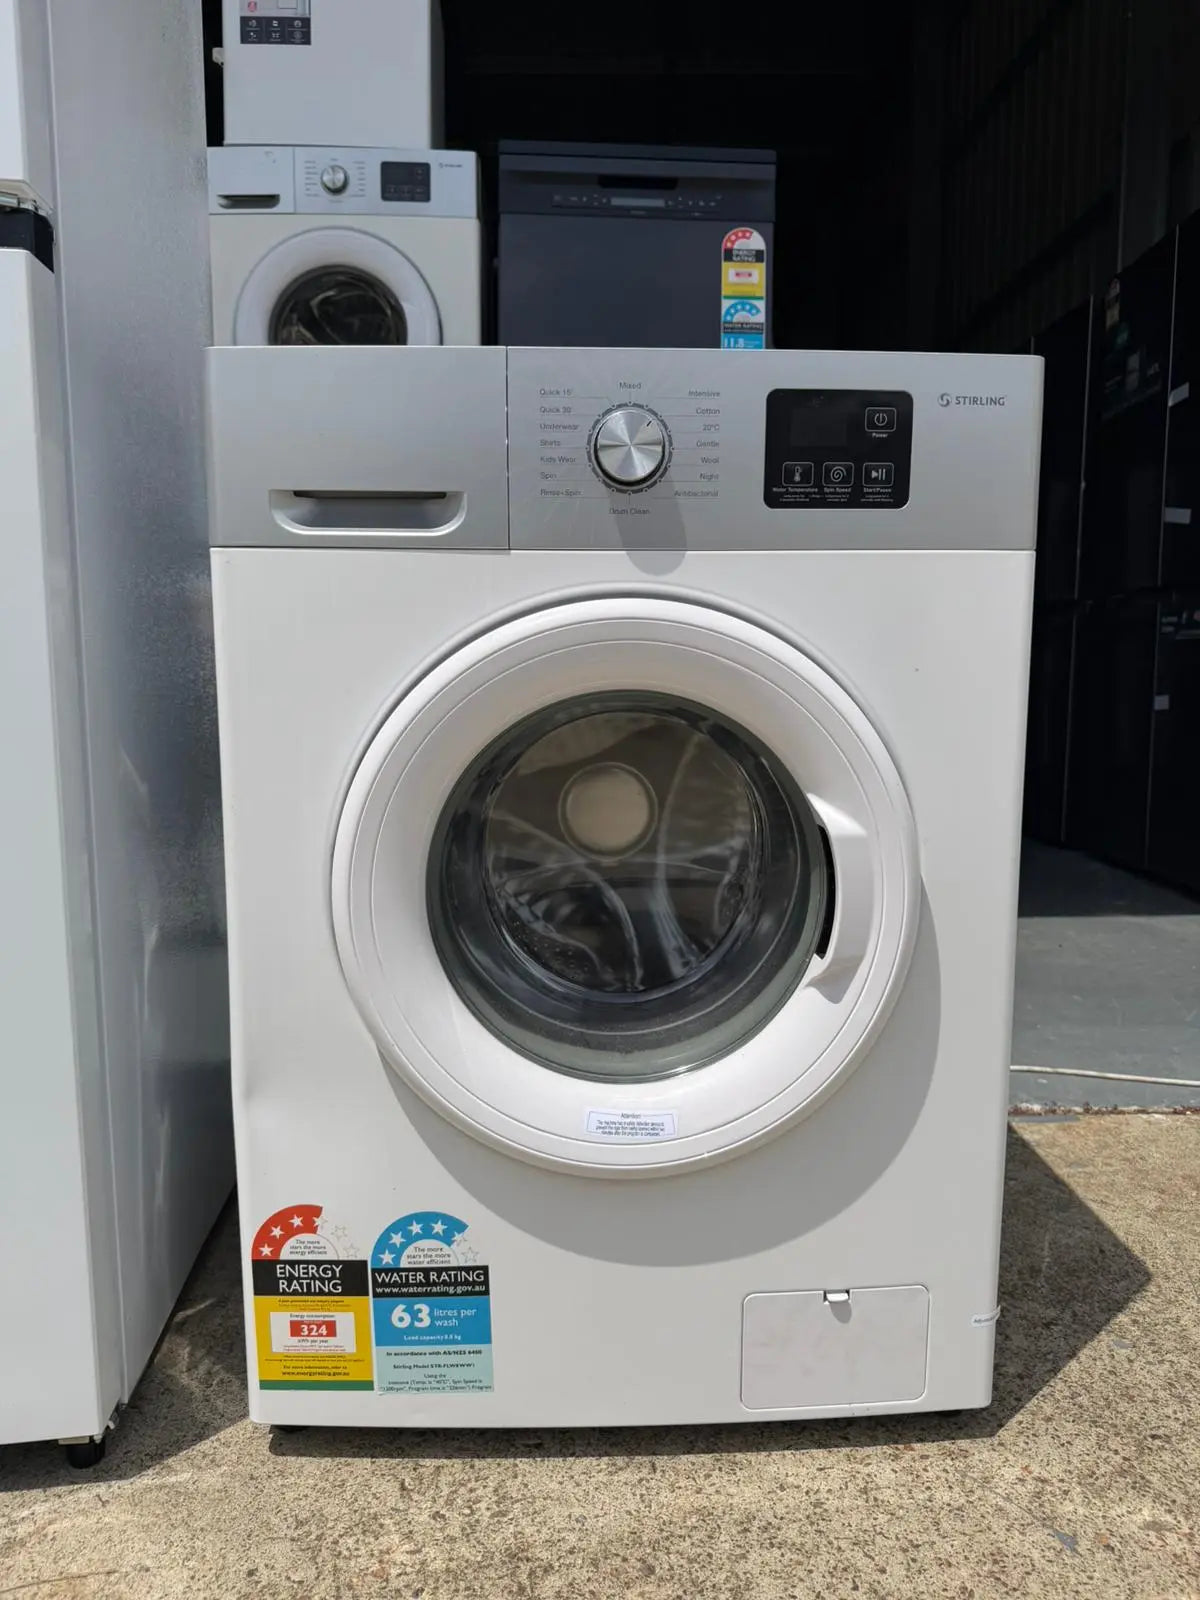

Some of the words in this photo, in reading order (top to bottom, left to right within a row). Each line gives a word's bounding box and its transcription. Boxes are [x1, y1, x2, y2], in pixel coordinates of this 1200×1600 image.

[955, 396, 1006, 406] STIRLING
[696, 407, 720, 415] Cotton
[701, 456, 720, 464] Wool
[540, 472, 557, 480] Spin
[700, 473, 719, 481] Night
[276, 1264, 343, 1278] ENERGY
[375, 1271, 426, 1284] WATER
[429, 1270, 485, 1283] RATING
[279, 1280, 342, 1293] RATING
[375, 1284, 486, 1294] www.waterrating.gov.au
[391, 1303, 431, 1329] 63
[434, 1308, 458, 1317] litres
[460, 1309, 477, 1318] per
[434, 1318, 459, 1327] wash
[300, 1324, 328, 1336] 324
